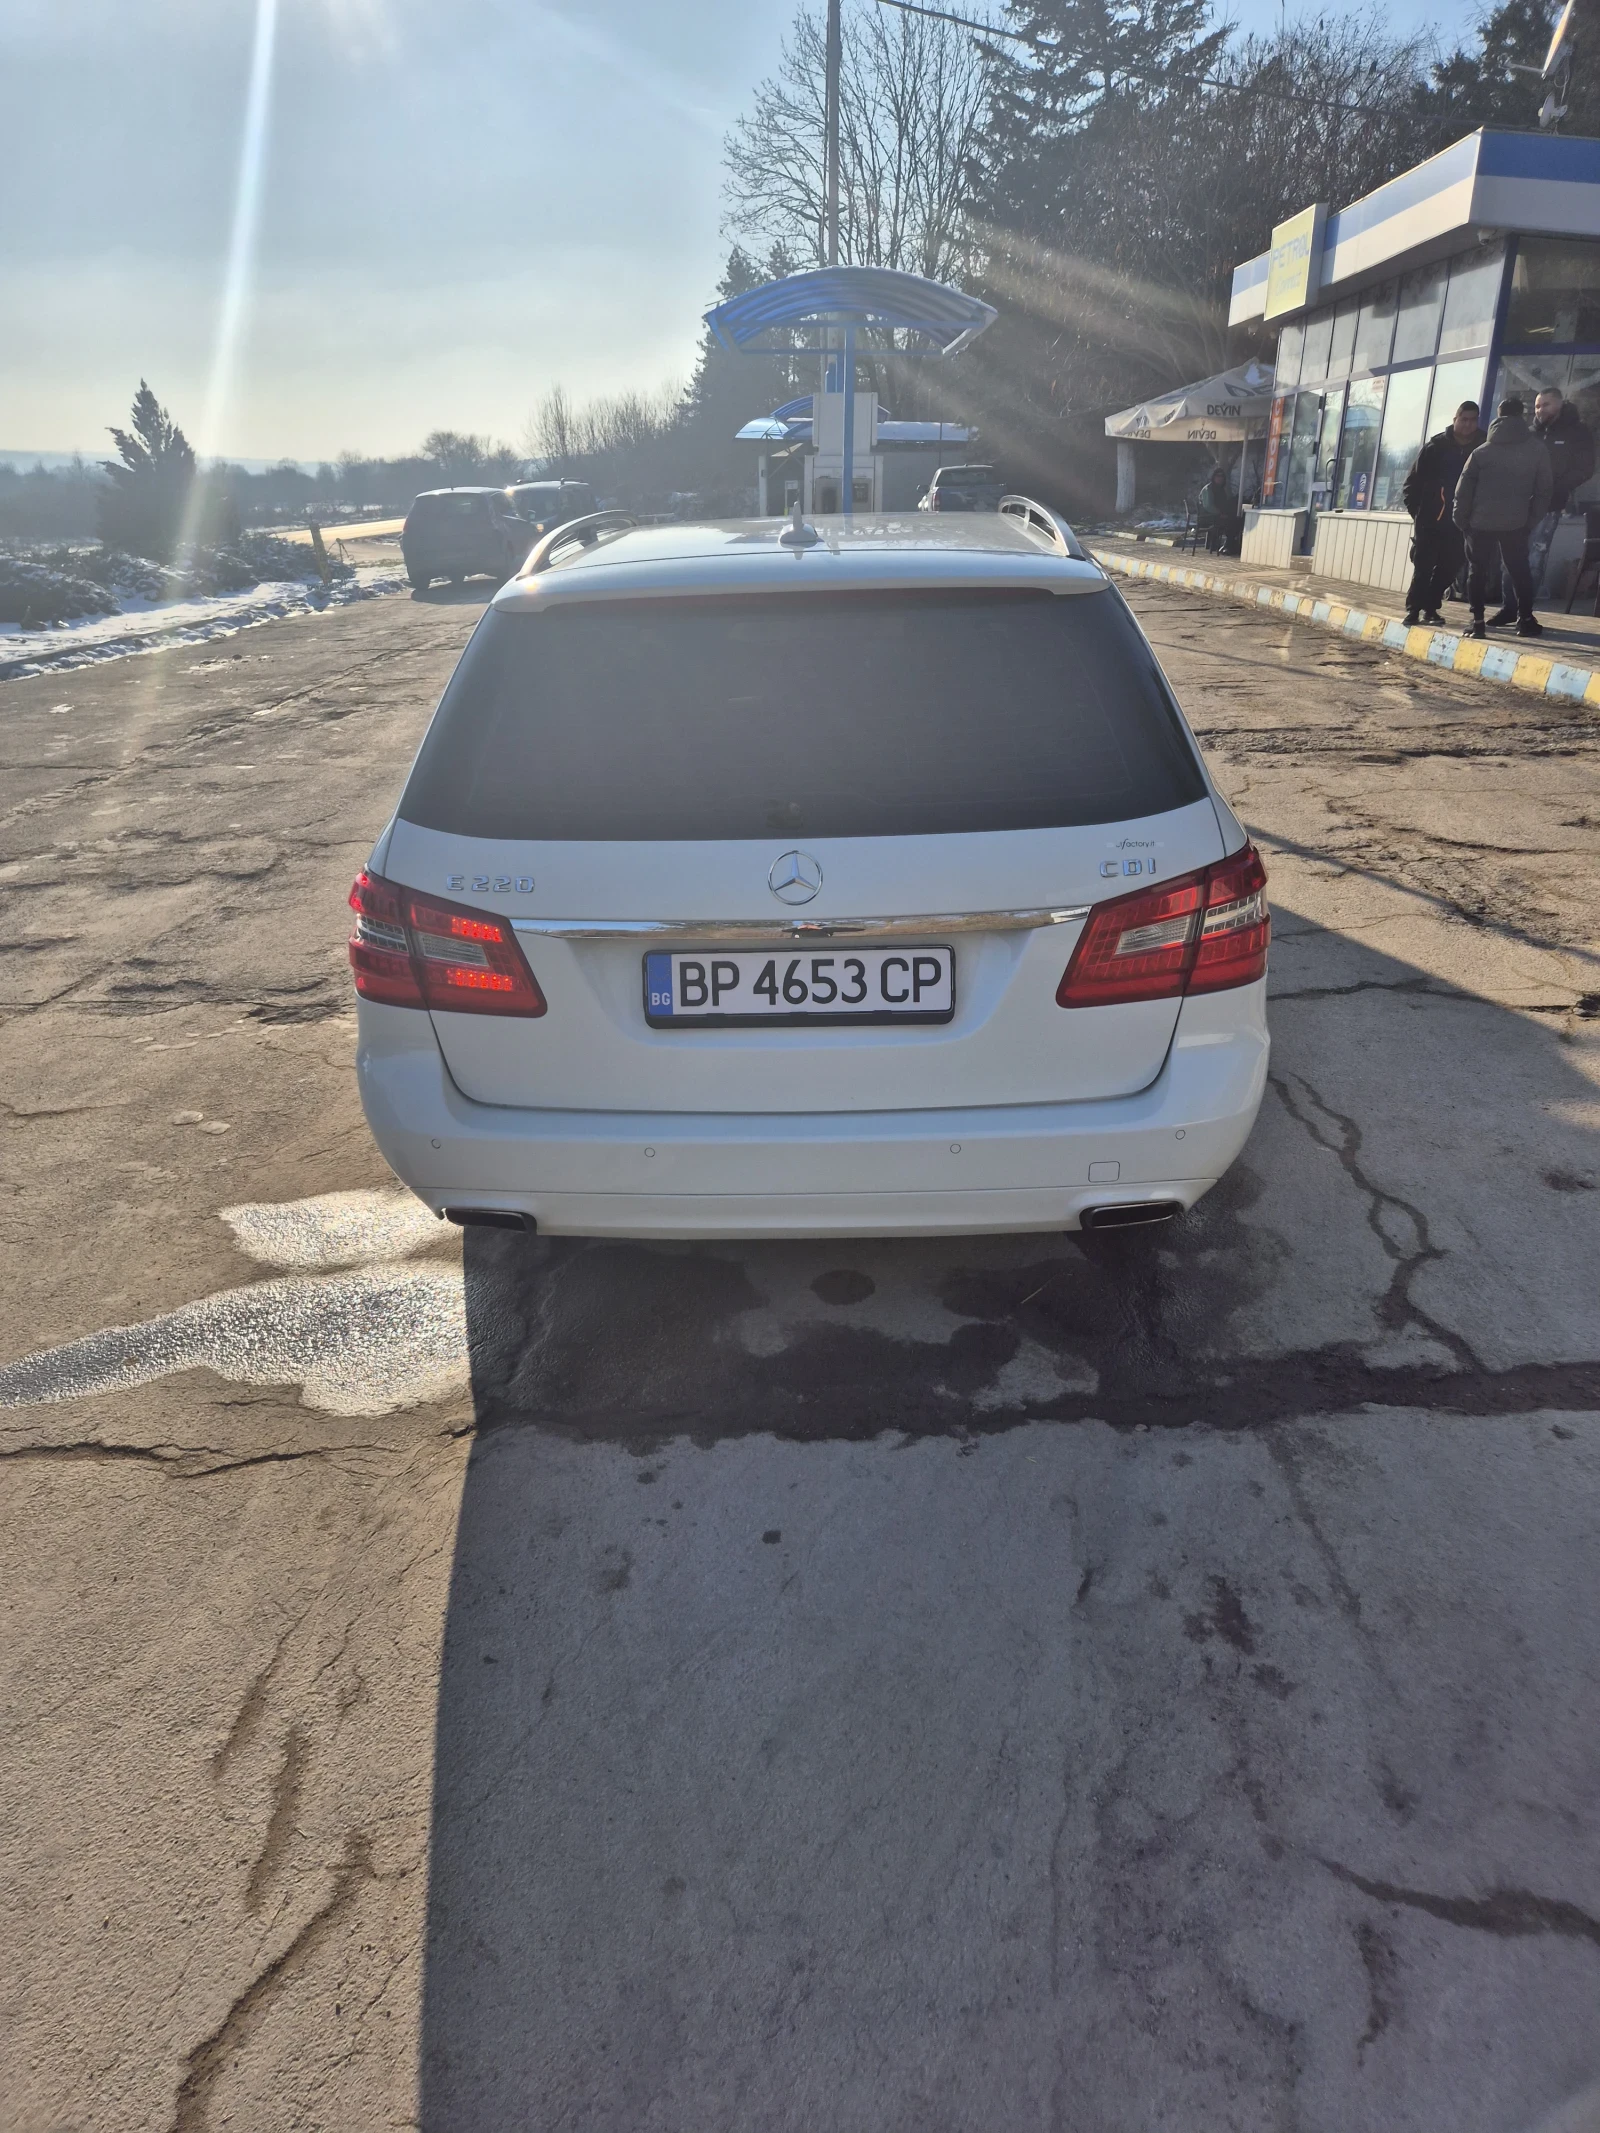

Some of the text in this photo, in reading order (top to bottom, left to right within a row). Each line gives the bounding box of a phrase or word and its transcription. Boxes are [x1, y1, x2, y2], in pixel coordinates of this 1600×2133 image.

[1272, 232, 1309, 269] PETROL
[1207, 404, 1241, 416] DEVIN
[1100, 858, 1156, 878] CDI
[447, 875, 535, 893] E 220
[679, 956, 942, 1007] BP 4653 CP
[651, 992, 671, 1006] BG
